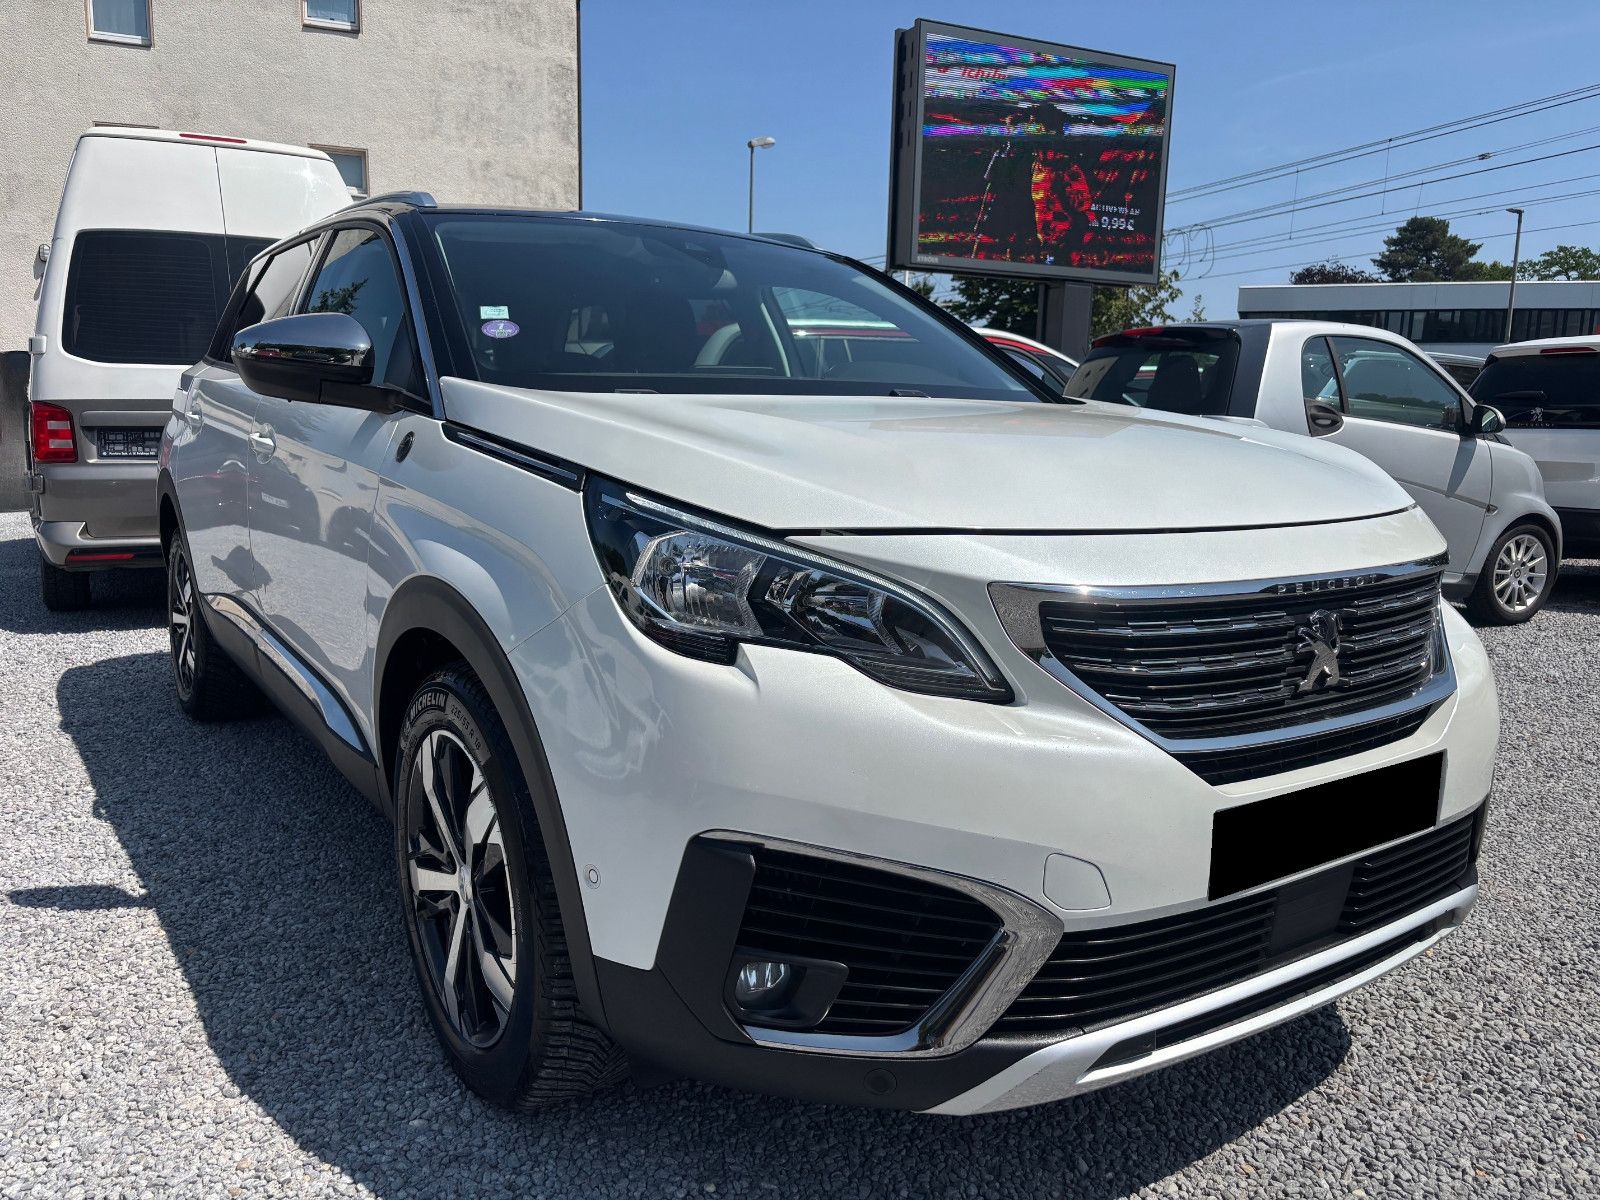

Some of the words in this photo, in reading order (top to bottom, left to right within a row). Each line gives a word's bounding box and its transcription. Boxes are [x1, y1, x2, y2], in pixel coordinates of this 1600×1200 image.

[1277, 574, 1378, 594] PEUGEOT
[410, 692, 446, 721] MICHELIN
[450, 704, 470, 730] 225/55
[469, 729, 475, 739] R
